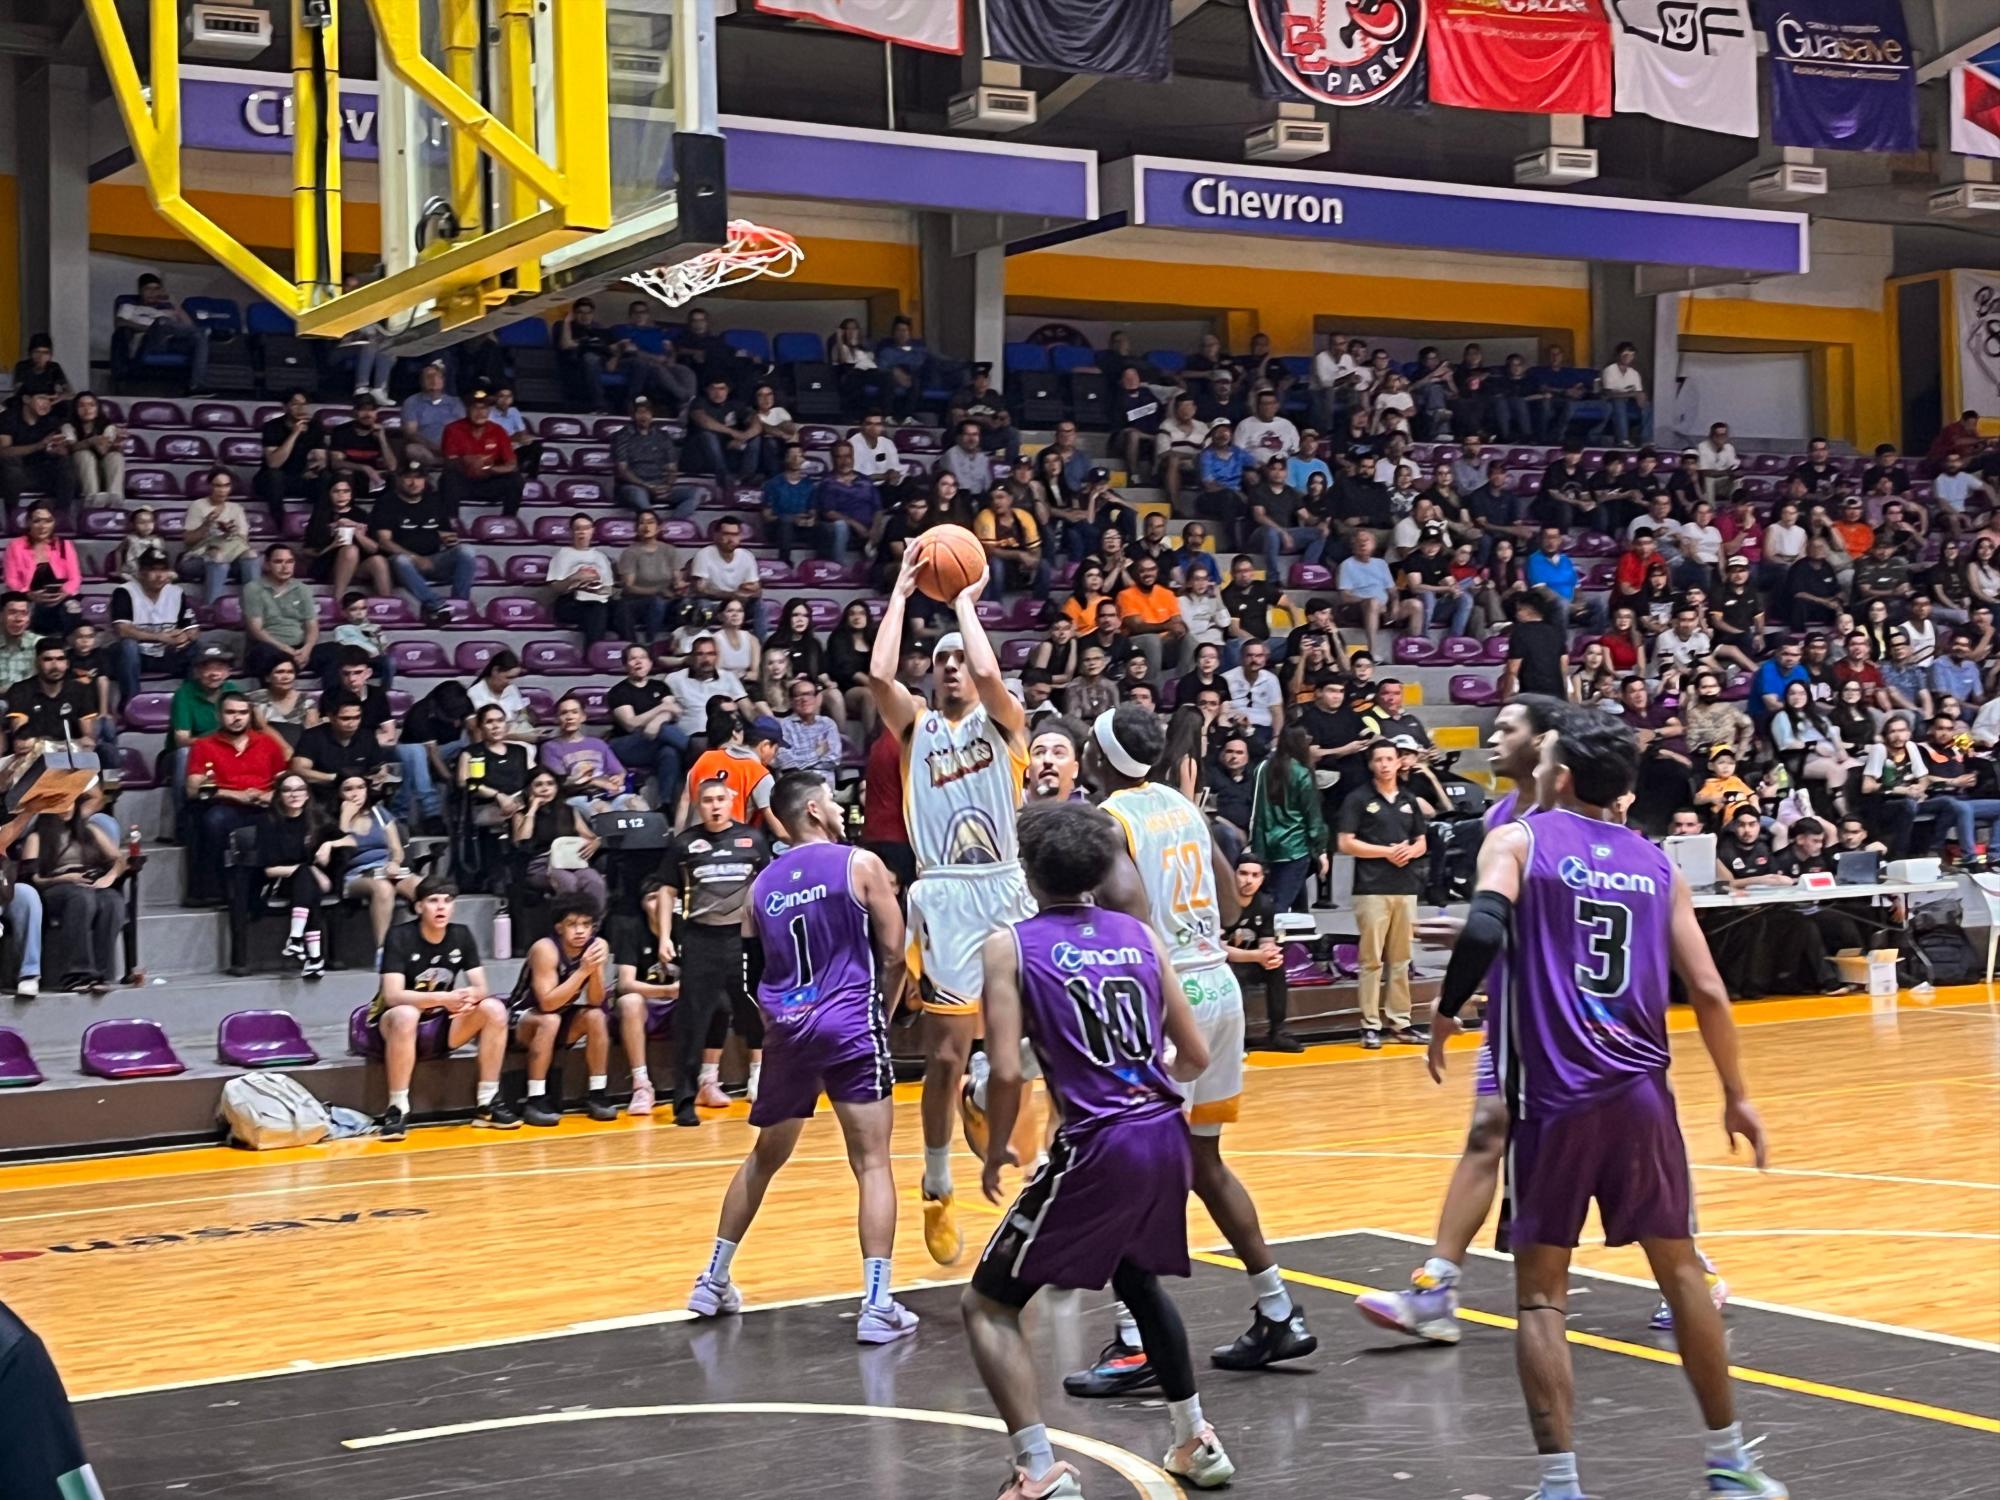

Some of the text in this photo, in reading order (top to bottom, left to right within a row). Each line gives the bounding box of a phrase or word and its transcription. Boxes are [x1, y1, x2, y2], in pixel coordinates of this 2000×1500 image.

[1326, 47, 1405, 93] PARK
[1191, 177, 1344, 224] Chevron
[629, 817, 645, 828] 12
[789, 913, 813, 988] 1
[1574, 896, 1633, 998] 3
[1064, 975, 1154, 1067] 10
